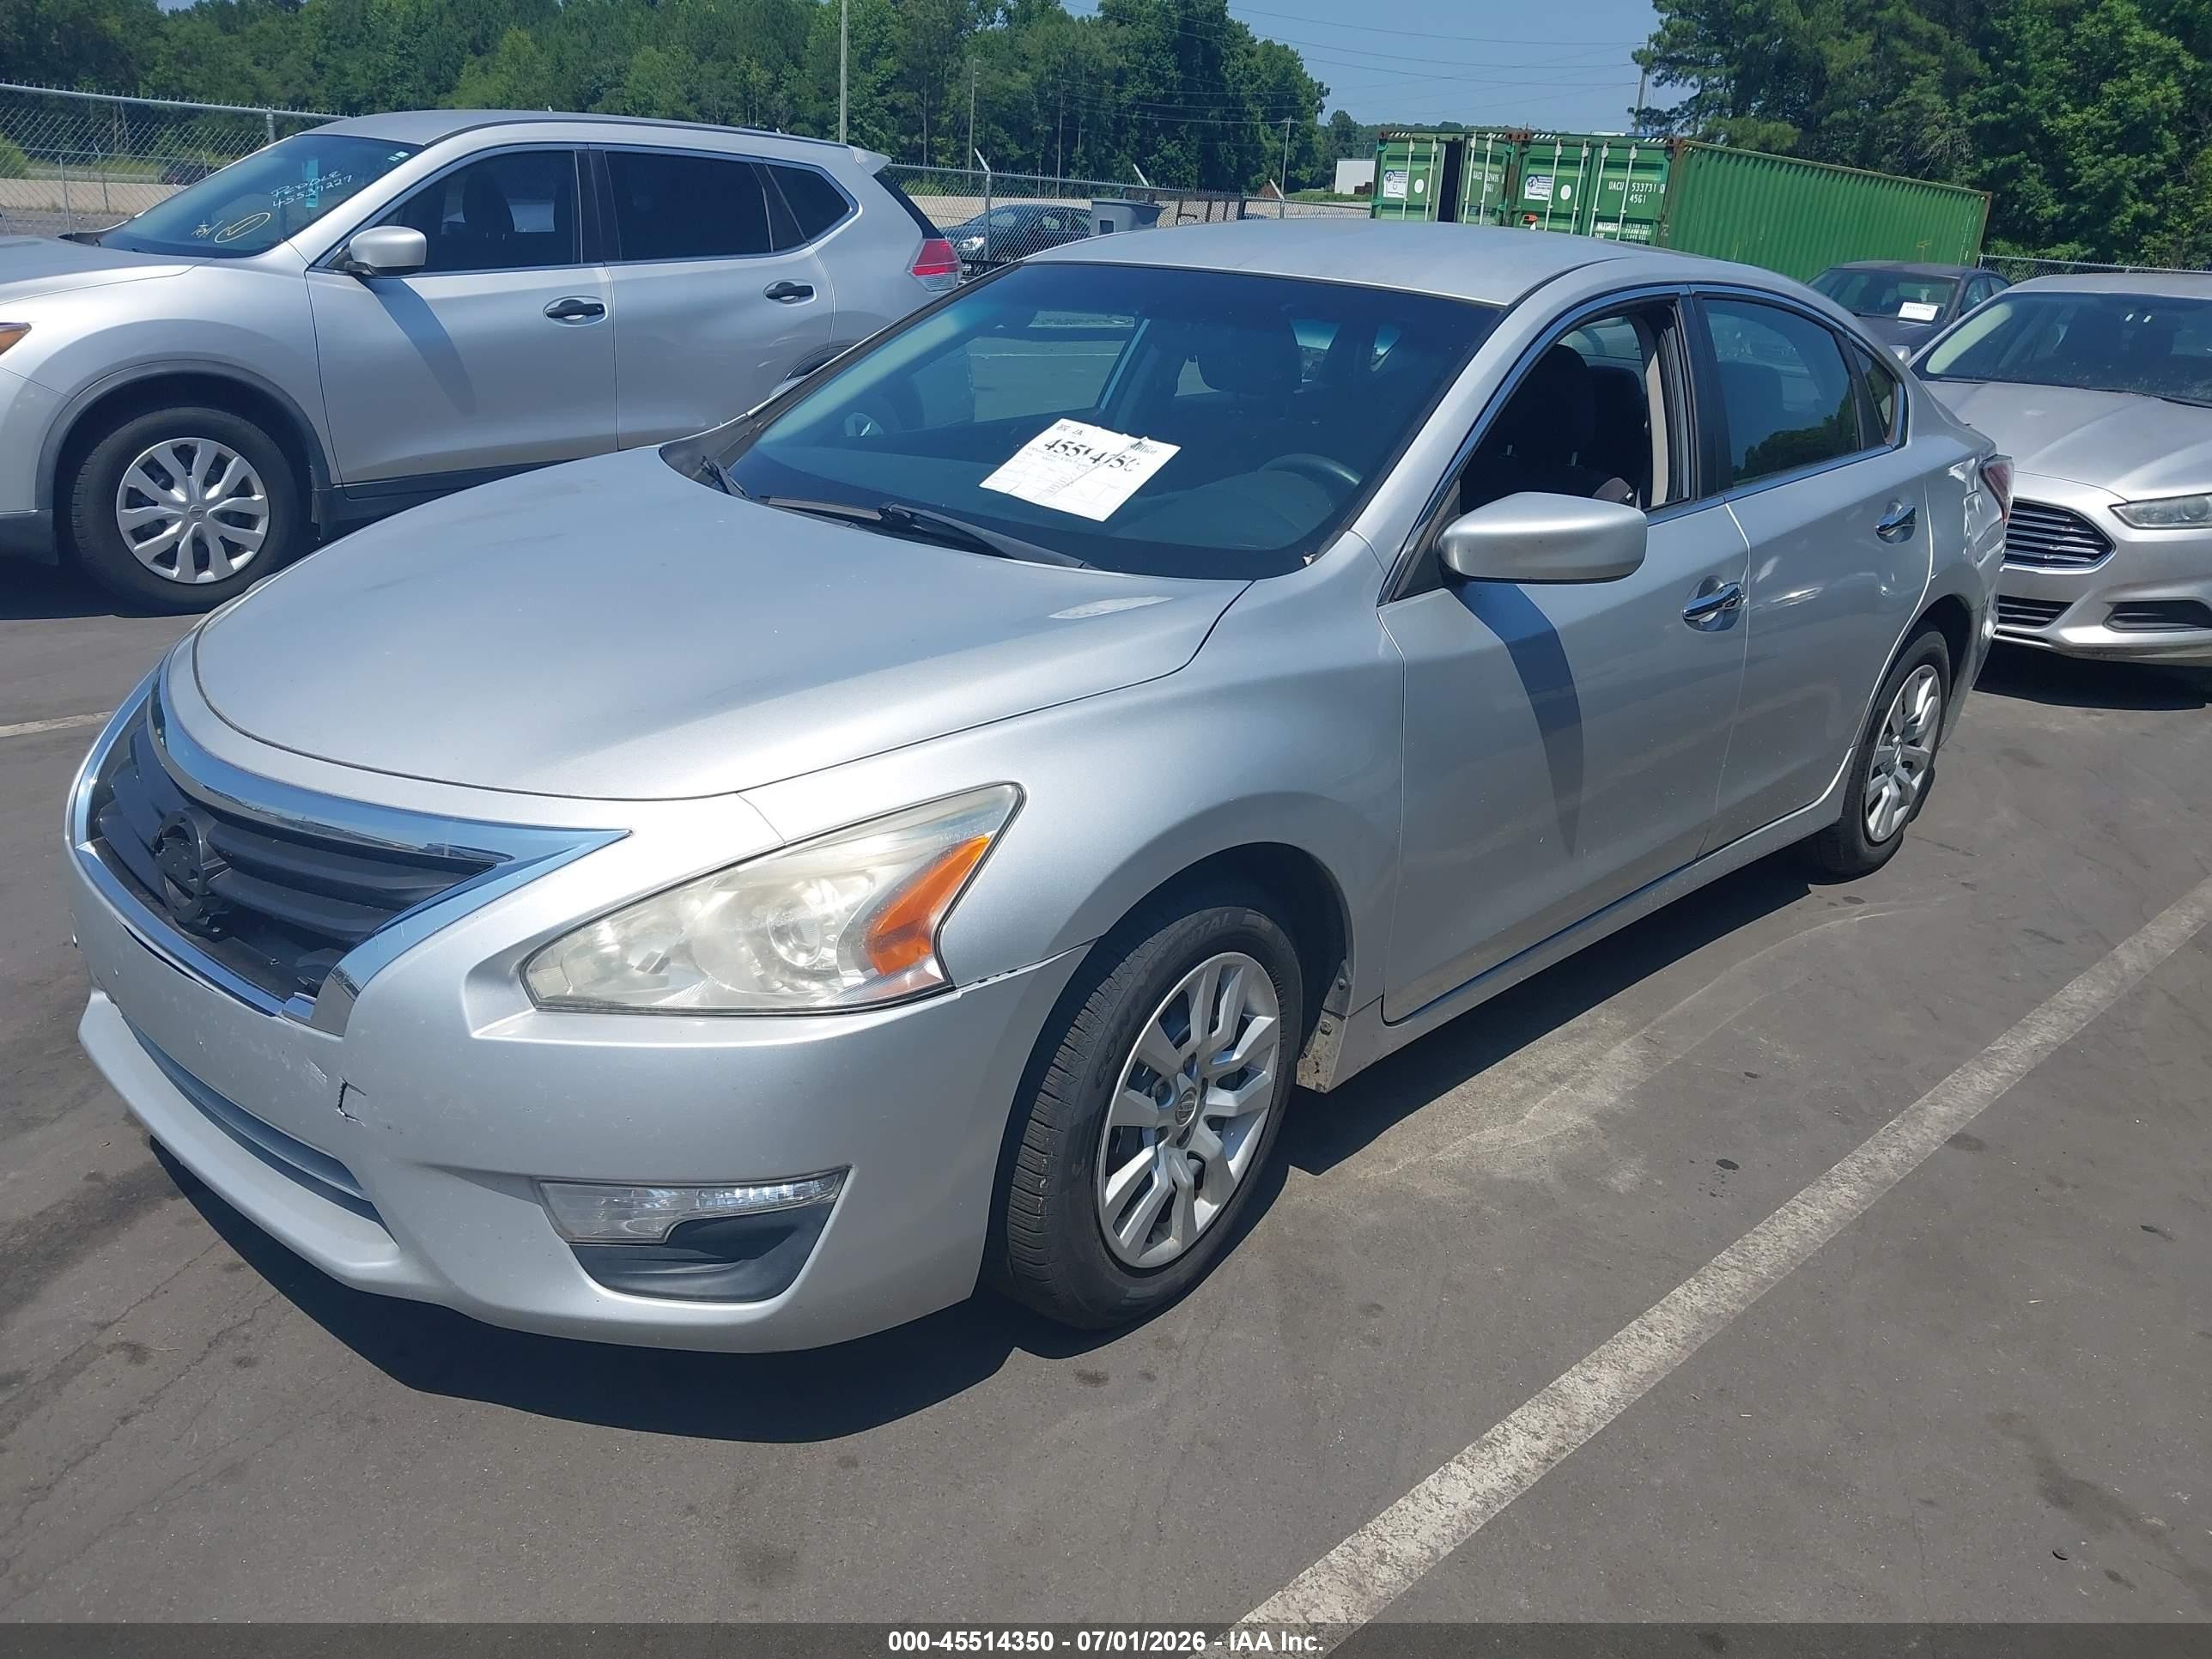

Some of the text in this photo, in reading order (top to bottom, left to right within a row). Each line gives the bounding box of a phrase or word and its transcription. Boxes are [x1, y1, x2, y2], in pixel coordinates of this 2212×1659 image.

[1608, 180, 1624, 191] UACU
[1632, 182, 1656, 193] 533731
[1629, 193, 1647, 204] 45G1
